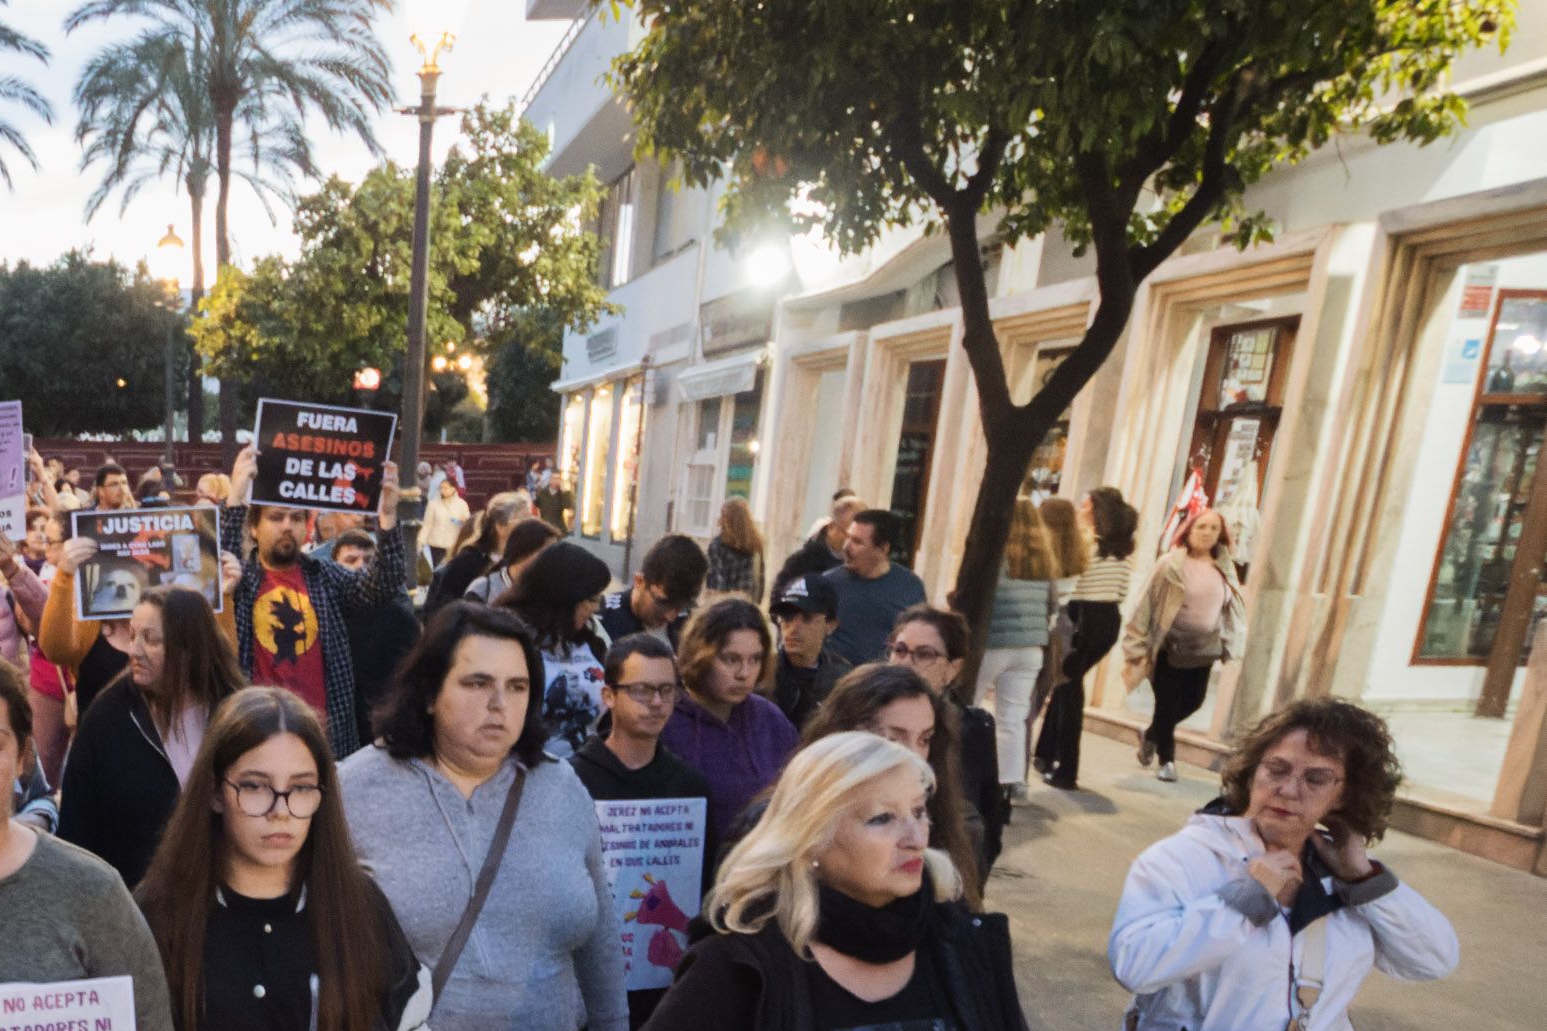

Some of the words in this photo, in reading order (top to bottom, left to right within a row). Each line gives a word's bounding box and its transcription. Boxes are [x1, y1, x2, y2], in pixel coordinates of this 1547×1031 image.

[296, 411, 358, 434] FUERA
[273, 431, 375, 458] ASESINOS
[285, 457, 314, 477] DE
[318, 461, 357, 481] LAS
[279, 480, 356, 505] CALLES
[4, 995, 26, 1013] NO
[33, 989, 101, 1011] ACEPTA
